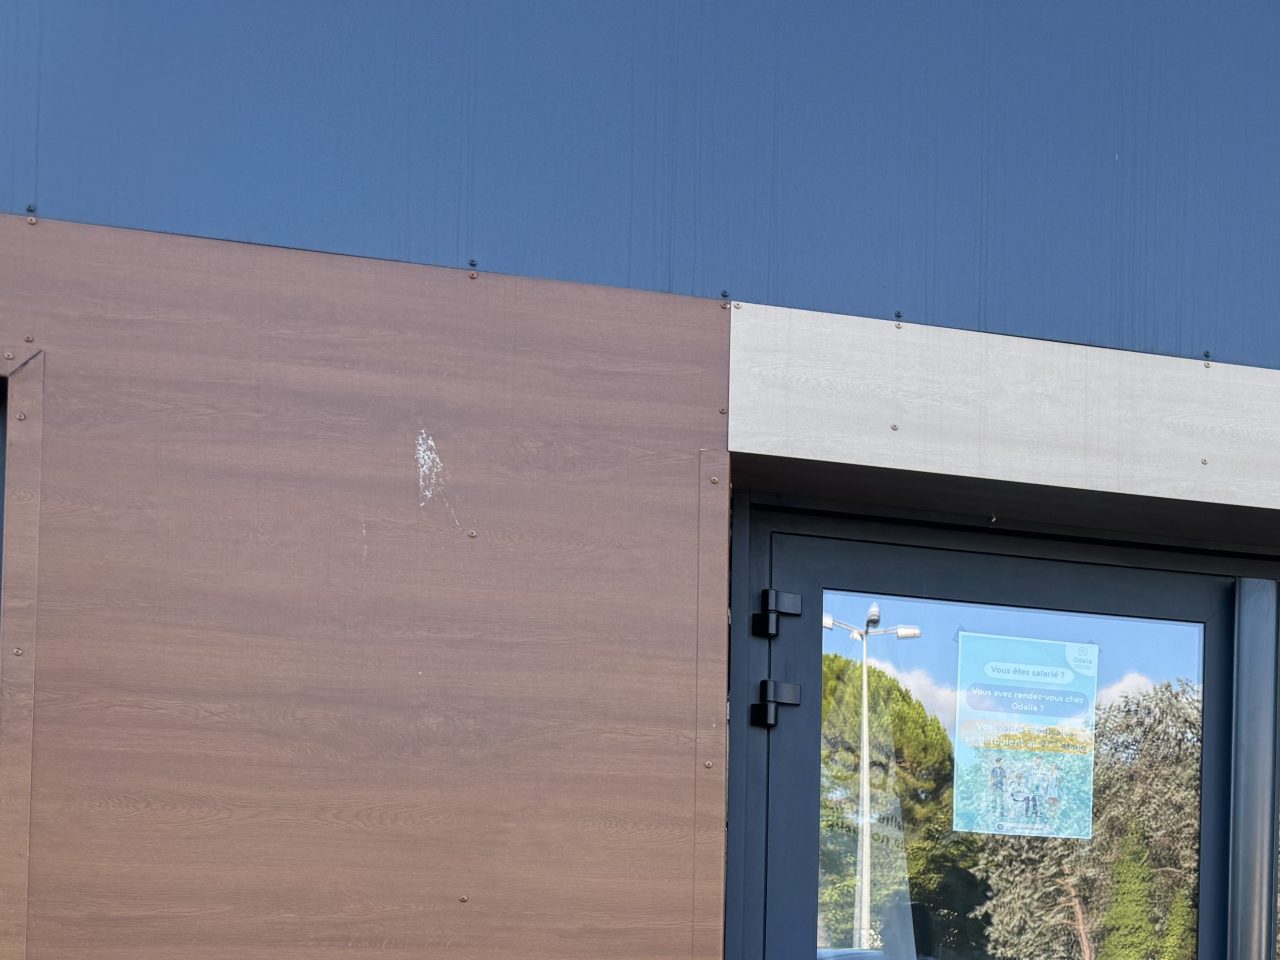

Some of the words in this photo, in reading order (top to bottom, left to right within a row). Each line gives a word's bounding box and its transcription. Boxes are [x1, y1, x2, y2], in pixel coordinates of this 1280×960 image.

[990, 665, 1010, 674] Vous
[1012, 667, 1030, 676] êtes
[1032, 668, 1058, 679] salarié
[971, 687, 991, 696] Vous
[993, 690, 1012, 698] avez
[1014, 692, 1063, 702] rendez-vous
[1065, 695, 1084, 704] chez
[1011, 702, 1038, 712] Odalia
